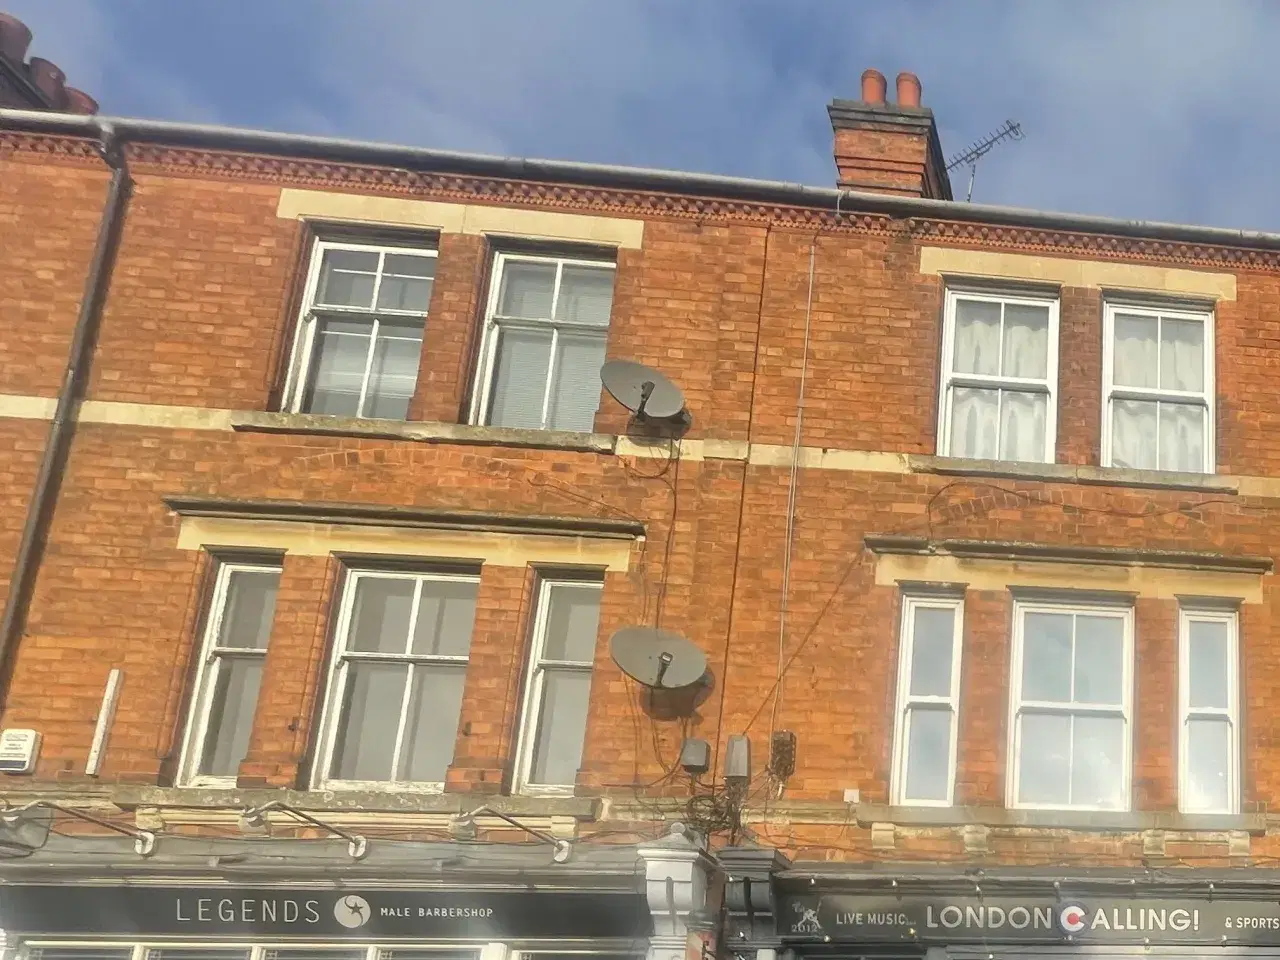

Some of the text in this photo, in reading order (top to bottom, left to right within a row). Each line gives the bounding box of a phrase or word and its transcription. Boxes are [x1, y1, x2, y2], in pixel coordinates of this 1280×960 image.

[176, 898, 320, 924] LEGENDS
[380, 906, 494, 918] MALE BARBERSHOP
[836, 913, 863, 925] LIVE
[926, 902, 1201, 936] LONDON CALLING!
[1225, 917, 1233, 928] &
[1236, 917, 1280, 930] SPORTS
